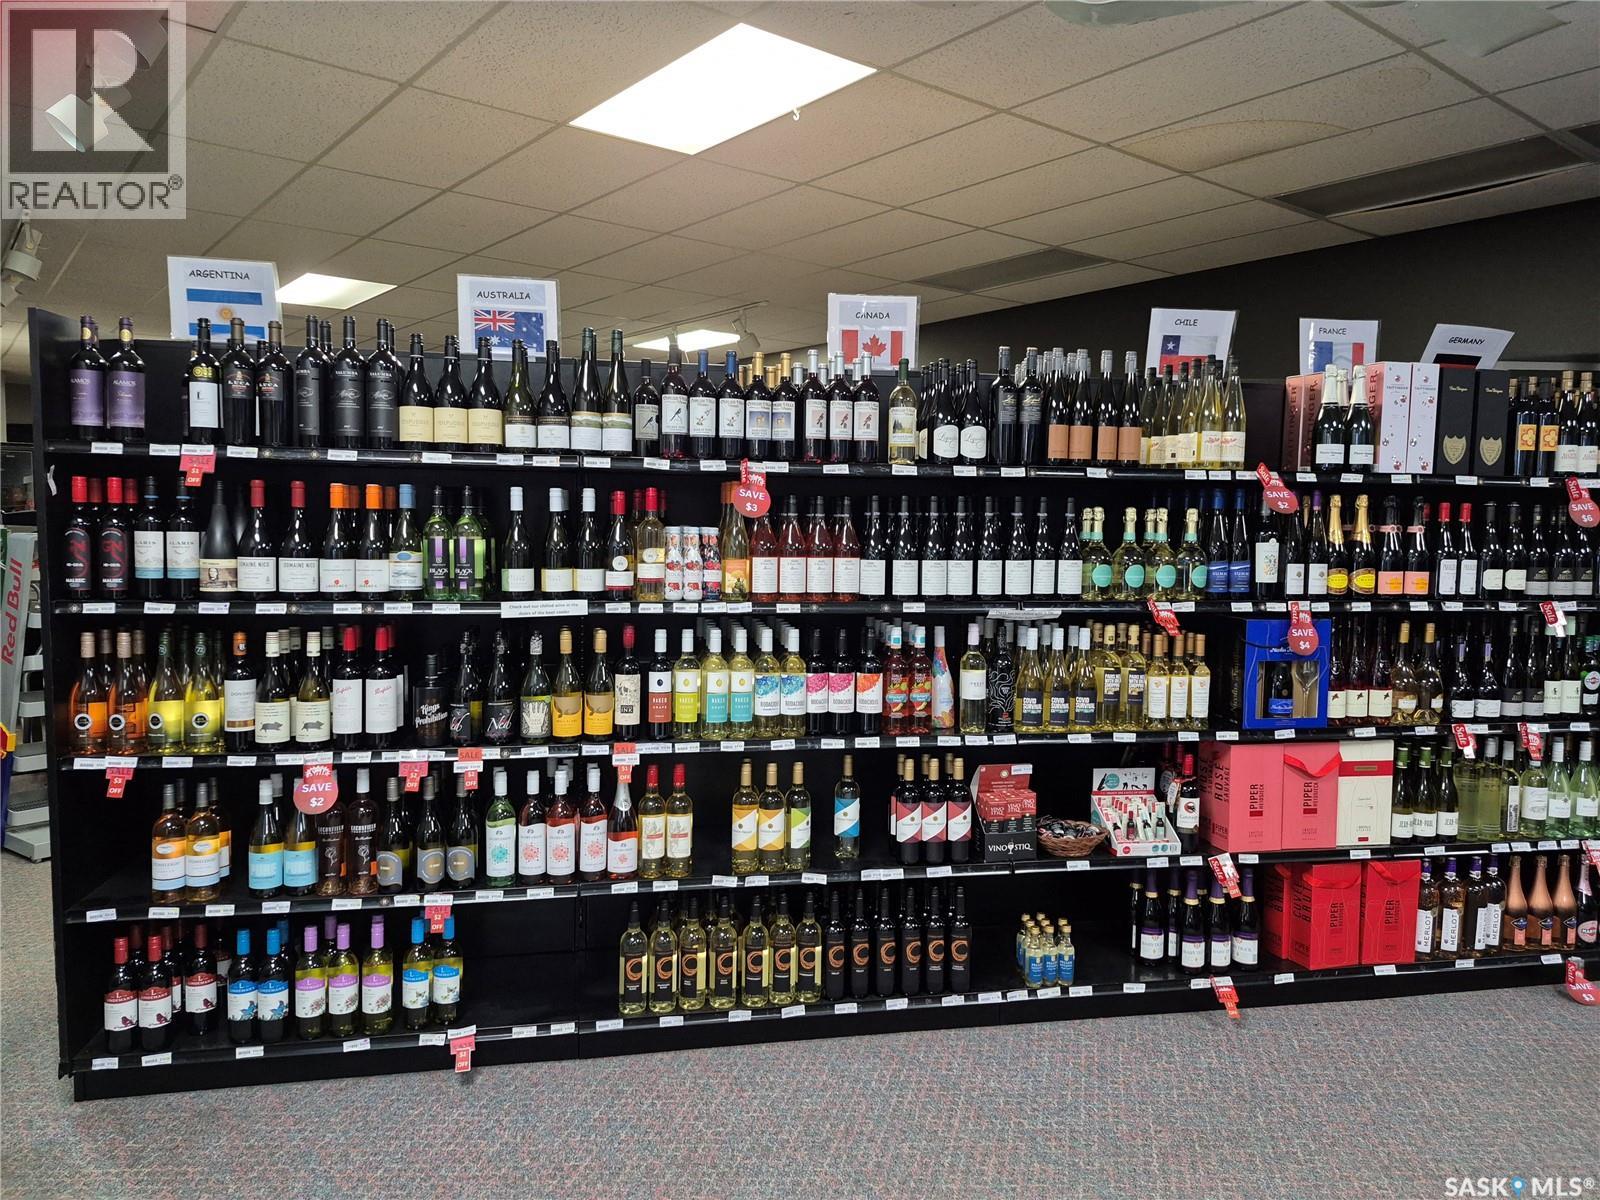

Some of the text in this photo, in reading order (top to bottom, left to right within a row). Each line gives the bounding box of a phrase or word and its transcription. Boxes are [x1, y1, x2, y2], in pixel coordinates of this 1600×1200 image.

[188, 269, 251, 281] ARGENTINA
[476, 290, 532, 301] AUSTRALIA
[854, 311, 891, 321] CANADA
[1174, 318, 1199, 327] CHILE
[1317, 327, 1347, 336] FRANCE
[1447, 335, 1486, 345] GERMANY
[739, 489, 766, 501] SAVE
[1266, 491, 1290, 499] SAVE
[745, 502, 758, 512] $3
[1277, 501, 1289, 510] $2
[1571, 502, 1595, 512] SAVE
[1, 557, 23, 665] Red Bull
[1543, 603, 1556, 623] Sale
[1292, 629, 1313, 637] SAVE
[1299, 640, 1311, 650] $4
[421, 703, 440, 715] Kings
[415, 711, 448, 728] Prohibition
[1455, 726, 1467, 745] Sale
[459, 752, 482, 760] SALE
[302, 783, 333, 793] SAVE
[1249, 784, 1258, 810] PIPER
[1303, 781, 1313, 807] PIPER
[310, 797, 325, 807] $2
[988, 843, 1034, 853] VINO STIQ
[1211, 859, 1224, 880] Sale
[1329, 902, 1338, 928] PIPER
[1384, 899, 1394, 925] PIPER
[1450, 914, 1458, 946] MERLOT
[1492, 909, 1500, 940] MERLOT
[1423, 915, 1432, 947] MERLOT
[1570, 982, 1592, 991] SAVE
